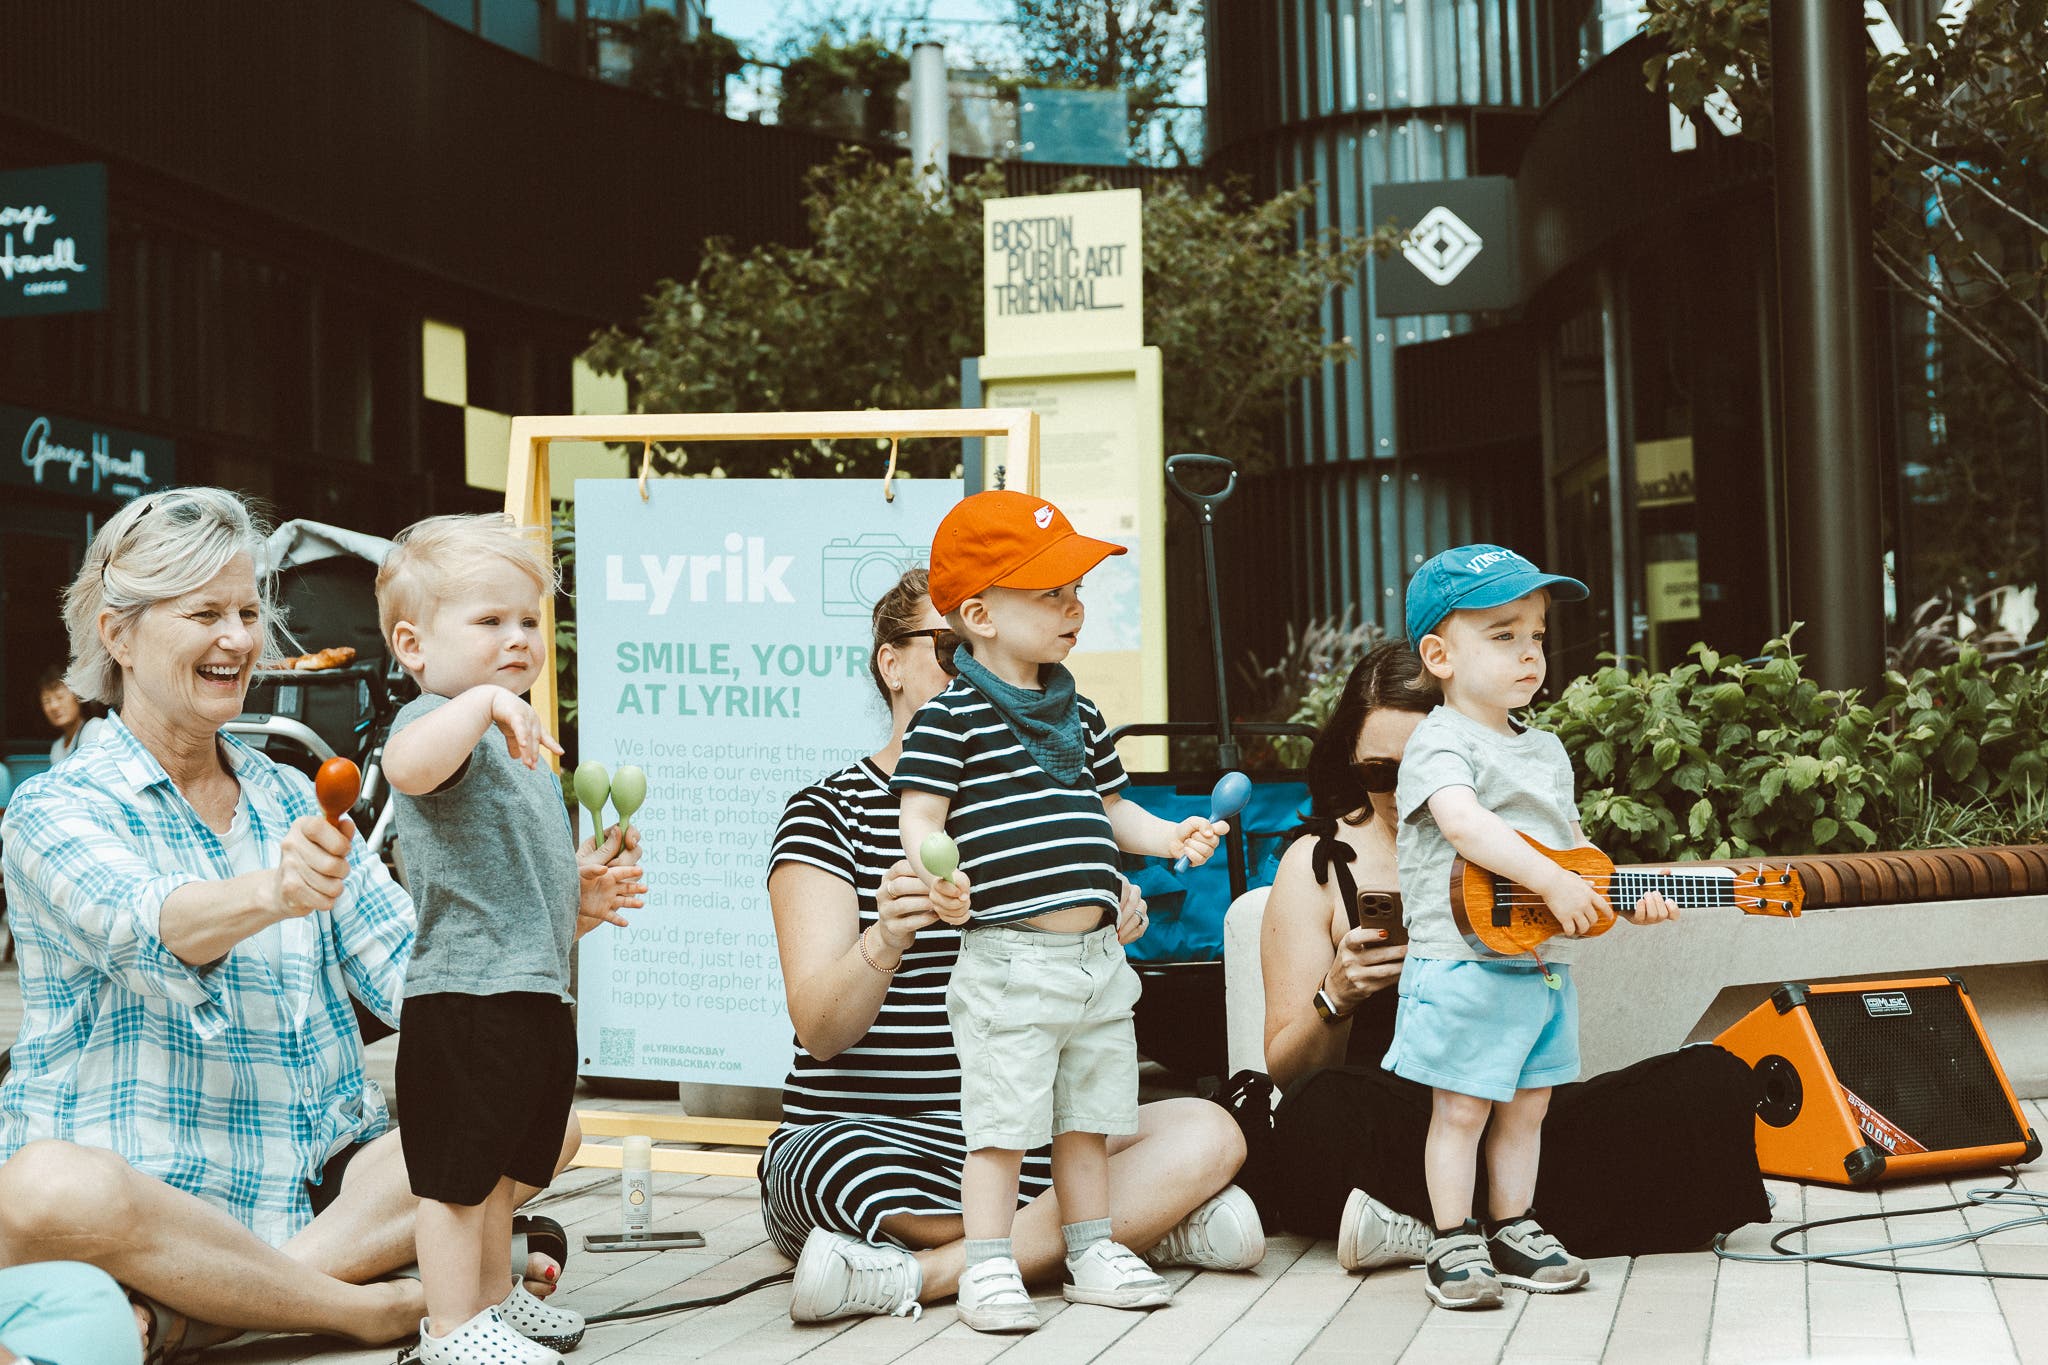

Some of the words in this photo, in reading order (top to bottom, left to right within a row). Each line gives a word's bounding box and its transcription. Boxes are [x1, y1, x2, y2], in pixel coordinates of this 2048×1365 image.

[993, 216, 1073, 251] BOSTON
[1008, 248, 1080, 285] PUBLIC
[1085, 245, 1126, 277] ART
[993, 279, 1125, 316] TRIENNIAL
[606, 532, 797, 616] Lyrik
[616, 641, 741, 681] SMILE,
[752, 643, 871, 678] YOU'R
[616, 684, 667, 715] AT
[678, 684, 801, 718] LYRIK!
[614, 738, 644, 757] We
[650, 739, 687, 758] love
[692, 741, 780, 764] capturing
[787, 743, 817, 761] the
[657, 761, 708, 780] make
[714, 767, 746, 781] our
[750, 766, 814, 782] events
[709, 785, 777, 807] today's
[673, 805, 709, 823] that
[714, 807, 780, 826] photos
[672, 826, 713, 844] here
[719, 831, 758, 850] may
[666, 847, 699, 868] Bay
[705, 847, 733, 866] for
[673, 891, 735, 911] media,
[741, 896, 761, 911] or
[629, 925, 679, 945] you'd
[684, 927, 741, 945] prefer
[747, 932, 777, 948] not
[613, 944, 695, 966] featured,
[700, 950, 735, 969] just
[740, 952, 763, 969] let
[612, 969, 630, 984] or
[636, 967, 762, 992] photographer
[612, 986, 668, 1010] happy
[672, 991, 691, 1008] to
[696, 994, 768, 1014] respect
[642, 1043, 726, 1057] @LYRIKBACKBAY
[642, 1056, 742, 1071] LYRIKBACKBAY.COM
[1860, 1117, 1897, 1151] 100W
[1894, 1133, 1907, 1144] PRO
